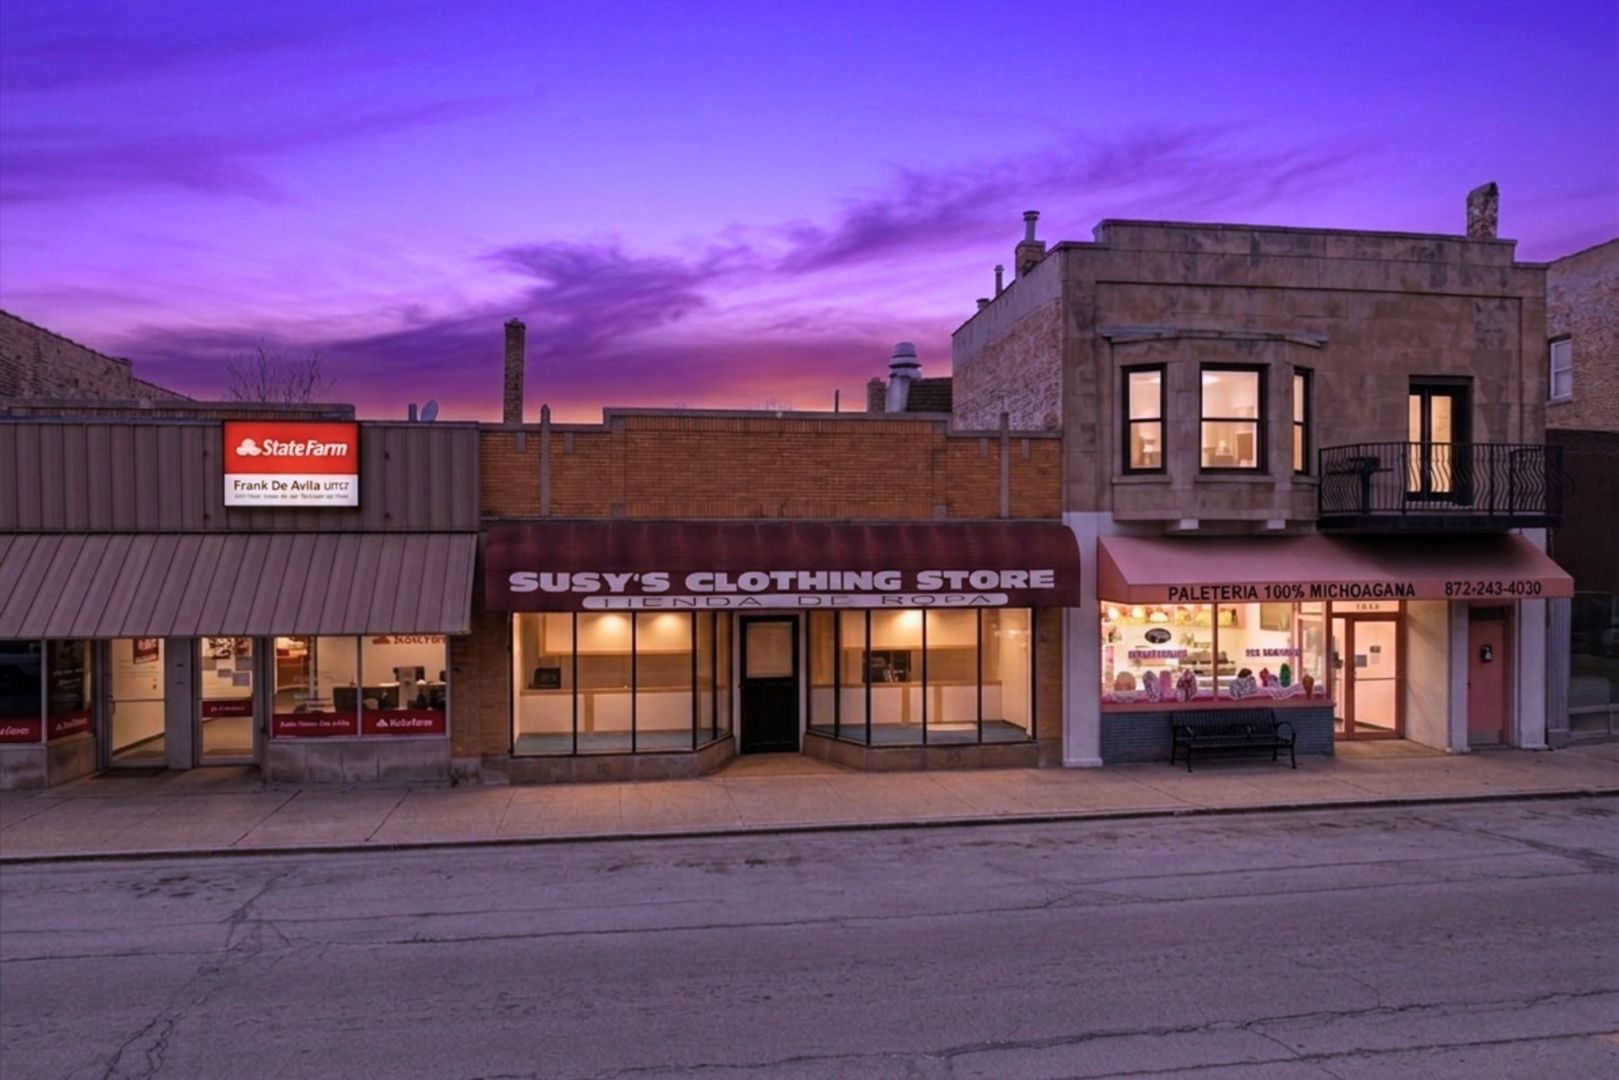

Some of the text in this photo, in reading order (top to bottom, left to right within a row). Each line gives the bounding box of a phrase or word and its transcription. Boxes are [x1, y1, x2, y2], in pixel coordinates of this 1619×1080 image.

[233, 480, 268, 490] Frank
[272, 480, 288, 490] De
[291, 480, 320, 490] Avila
[508, 570, 1055, 593] SUSY'S CLOTHING STORE
[1168, 581, 1542, 601] PALETERIA 100% MICHOAGANA 872-243-4030
[600, 595, 992, 608] TIENDA DE ROPA
